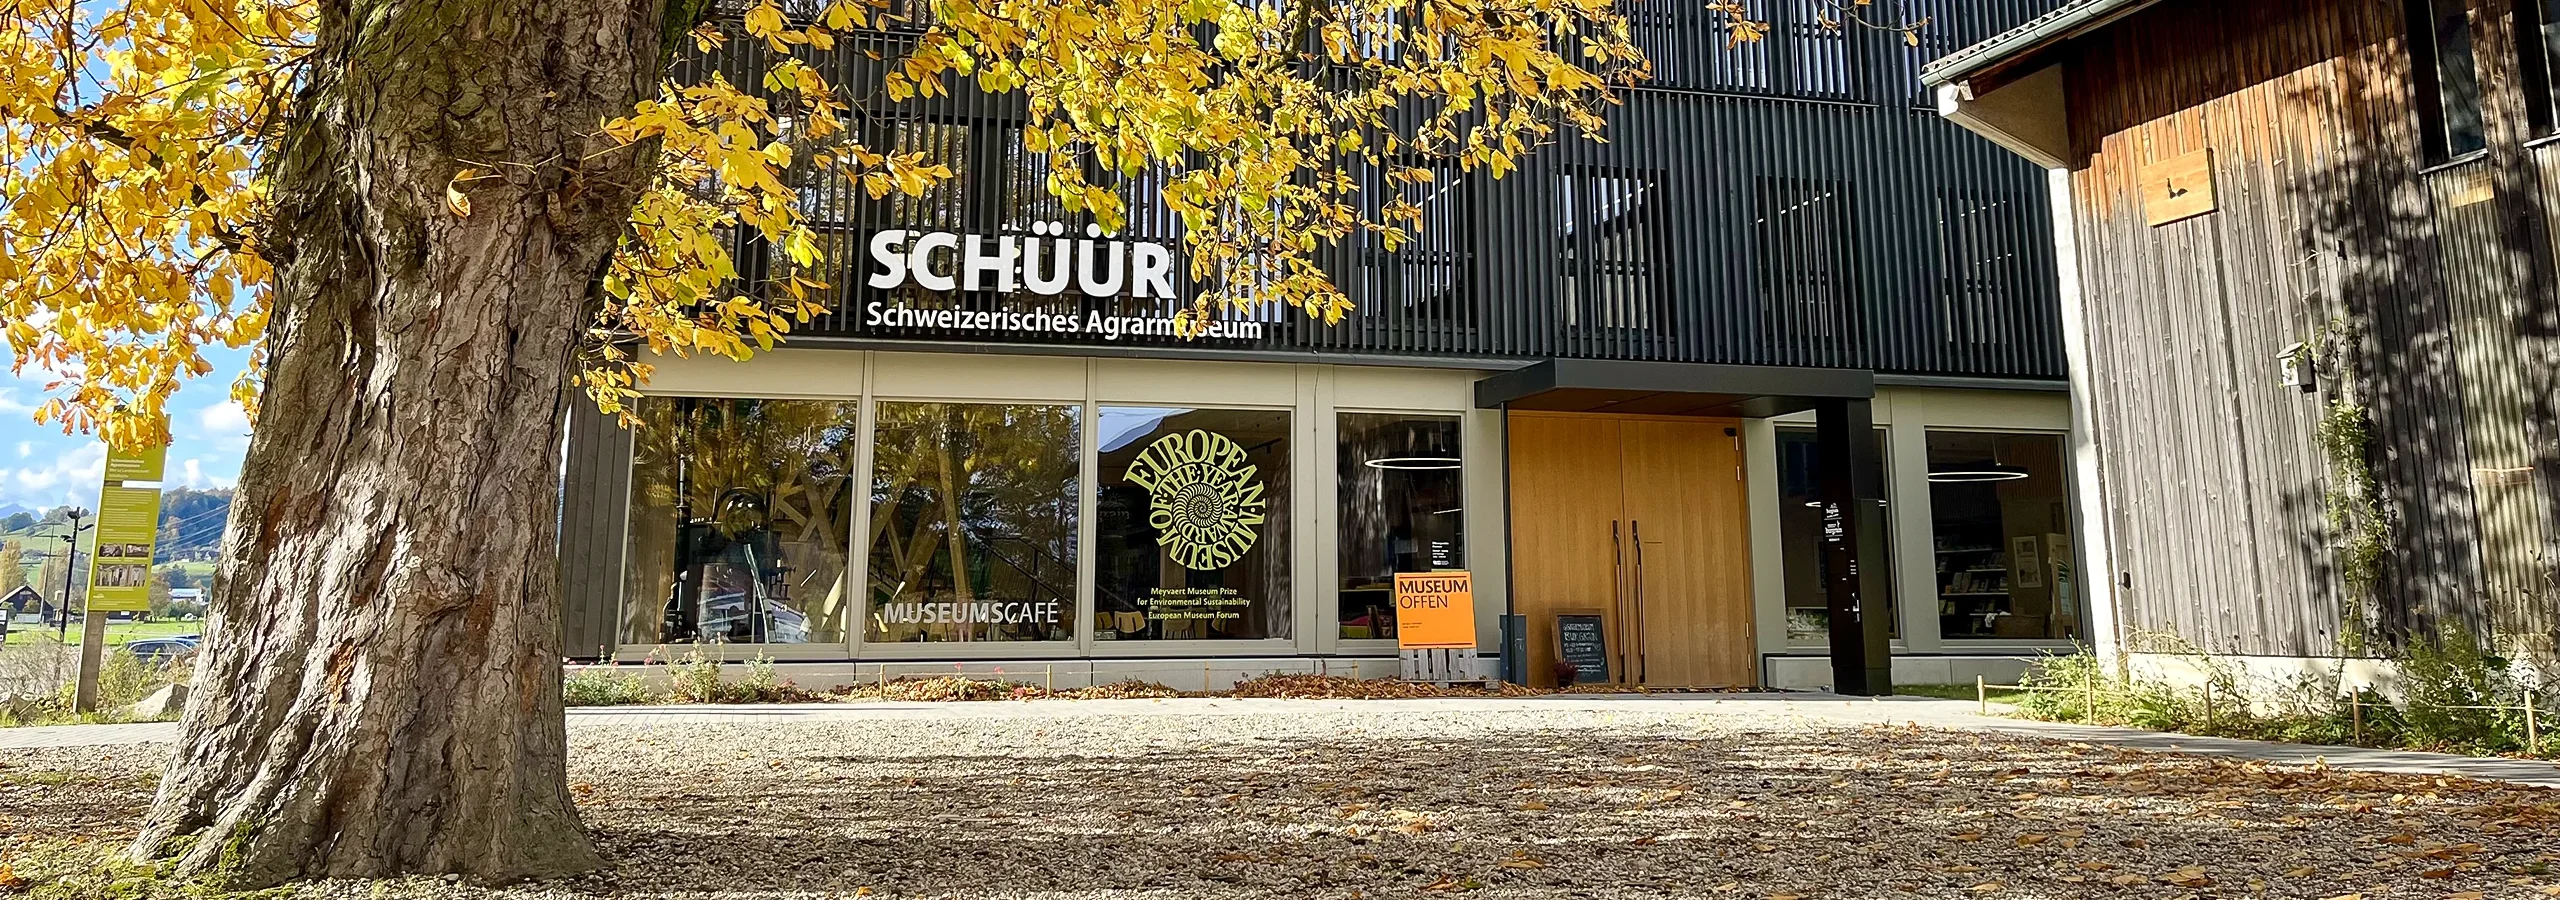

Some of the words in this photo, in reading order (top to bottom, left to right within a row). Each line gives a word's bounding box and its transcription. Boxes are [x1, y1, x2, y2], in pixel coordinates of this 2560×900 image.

[868, 220, 1177, 299] SCHÜÜR
[867, 301, 1079, 332] Schweizerisches
[1123, 429, 1266, 508] EUROPEAN
[1156, 463, 1199, 498] THE
[1200, 464, 1240, 507] YEAR
[1149, 494, 1174, 530] OF
[1181, 509, 1239, 544] AWARD
[1156, 508, 1266, 571] MUSEUM
[1137, 597, 1148, 606] for
[1150, 597, 1202, 606] Environmental
[1203, 597, 1251, 608] Sustainability
[1150, 587, 1186, 597] Meyvaert
[1187, 587, 1219, 595] Museum
[1219, 587, 1238, 595] Prize
[1399, 579, 1468, 594] MUSEUM
[1400, 595, 1449, 609] OFFEN
[883, 597, 1059, 624] MUSEUMSCAFÉ
[1148, 611, 1182, 621] European
[1183, 611, 1215, 620] Museum
[1216, 611, 1240, 620] Forum
